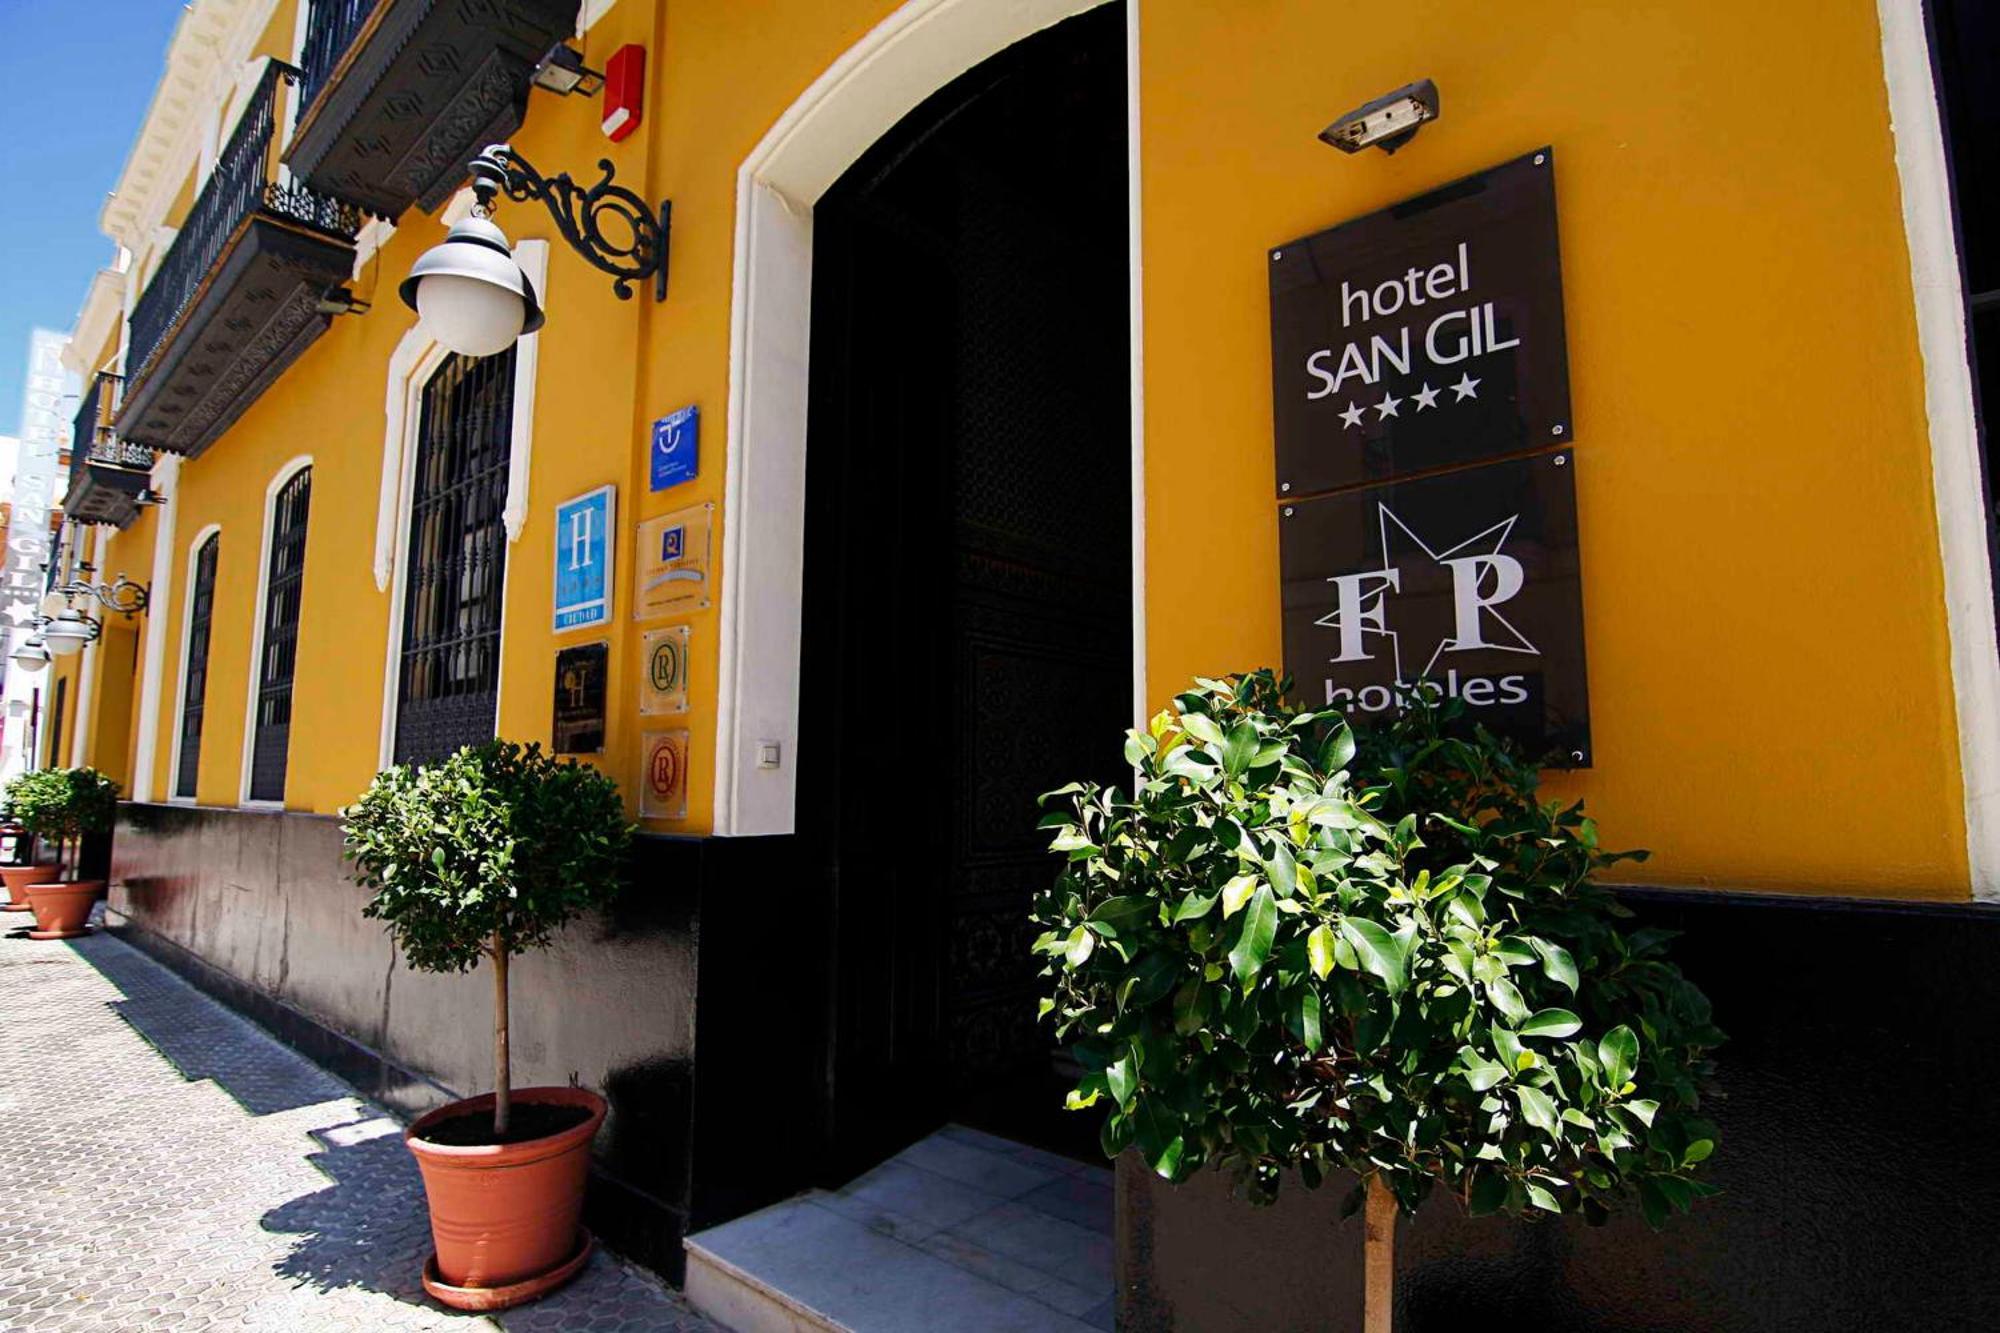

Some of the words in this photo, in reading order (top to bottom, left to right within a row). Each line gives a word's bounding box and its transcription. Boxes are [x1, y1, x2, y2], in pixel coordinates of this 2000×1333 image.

[1341, 243, 1470, 328] hotel
[1306, 327, 1412, 401] SAN
[1425, 302, 1521, 366] GIL
[8, 537, 42, 588] GIL
[568, 507, 595, 571] H
[657, 653, 673, 684] R
[1325, 668, 1529, 717] hoteles
[657, 756, 673, 786] R
